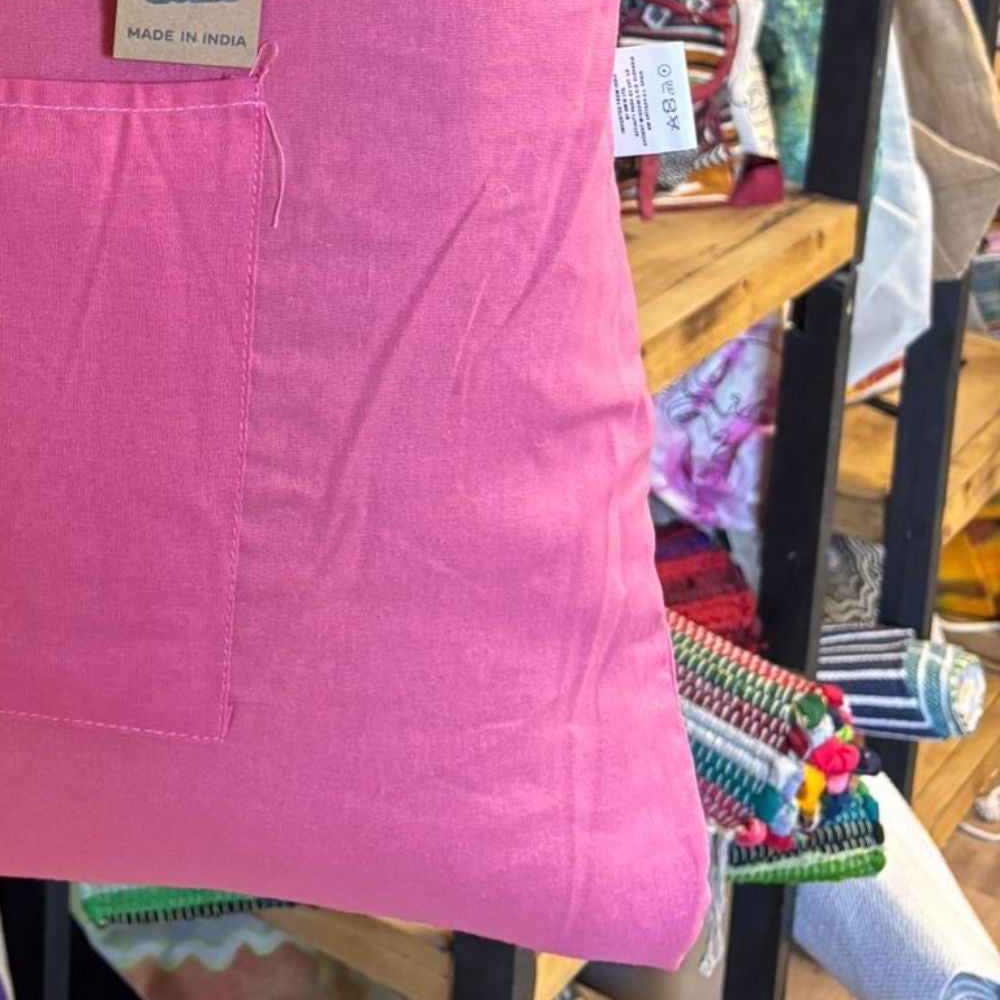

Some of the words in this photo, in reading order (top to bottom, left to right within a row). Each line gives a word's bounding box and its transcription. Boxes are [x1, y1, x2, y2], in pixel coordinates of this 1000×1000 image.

[127, 27, 174, 42] MADE
[180, 30, 197, 43] IN
[203, 32, 247, 47] INDIA
